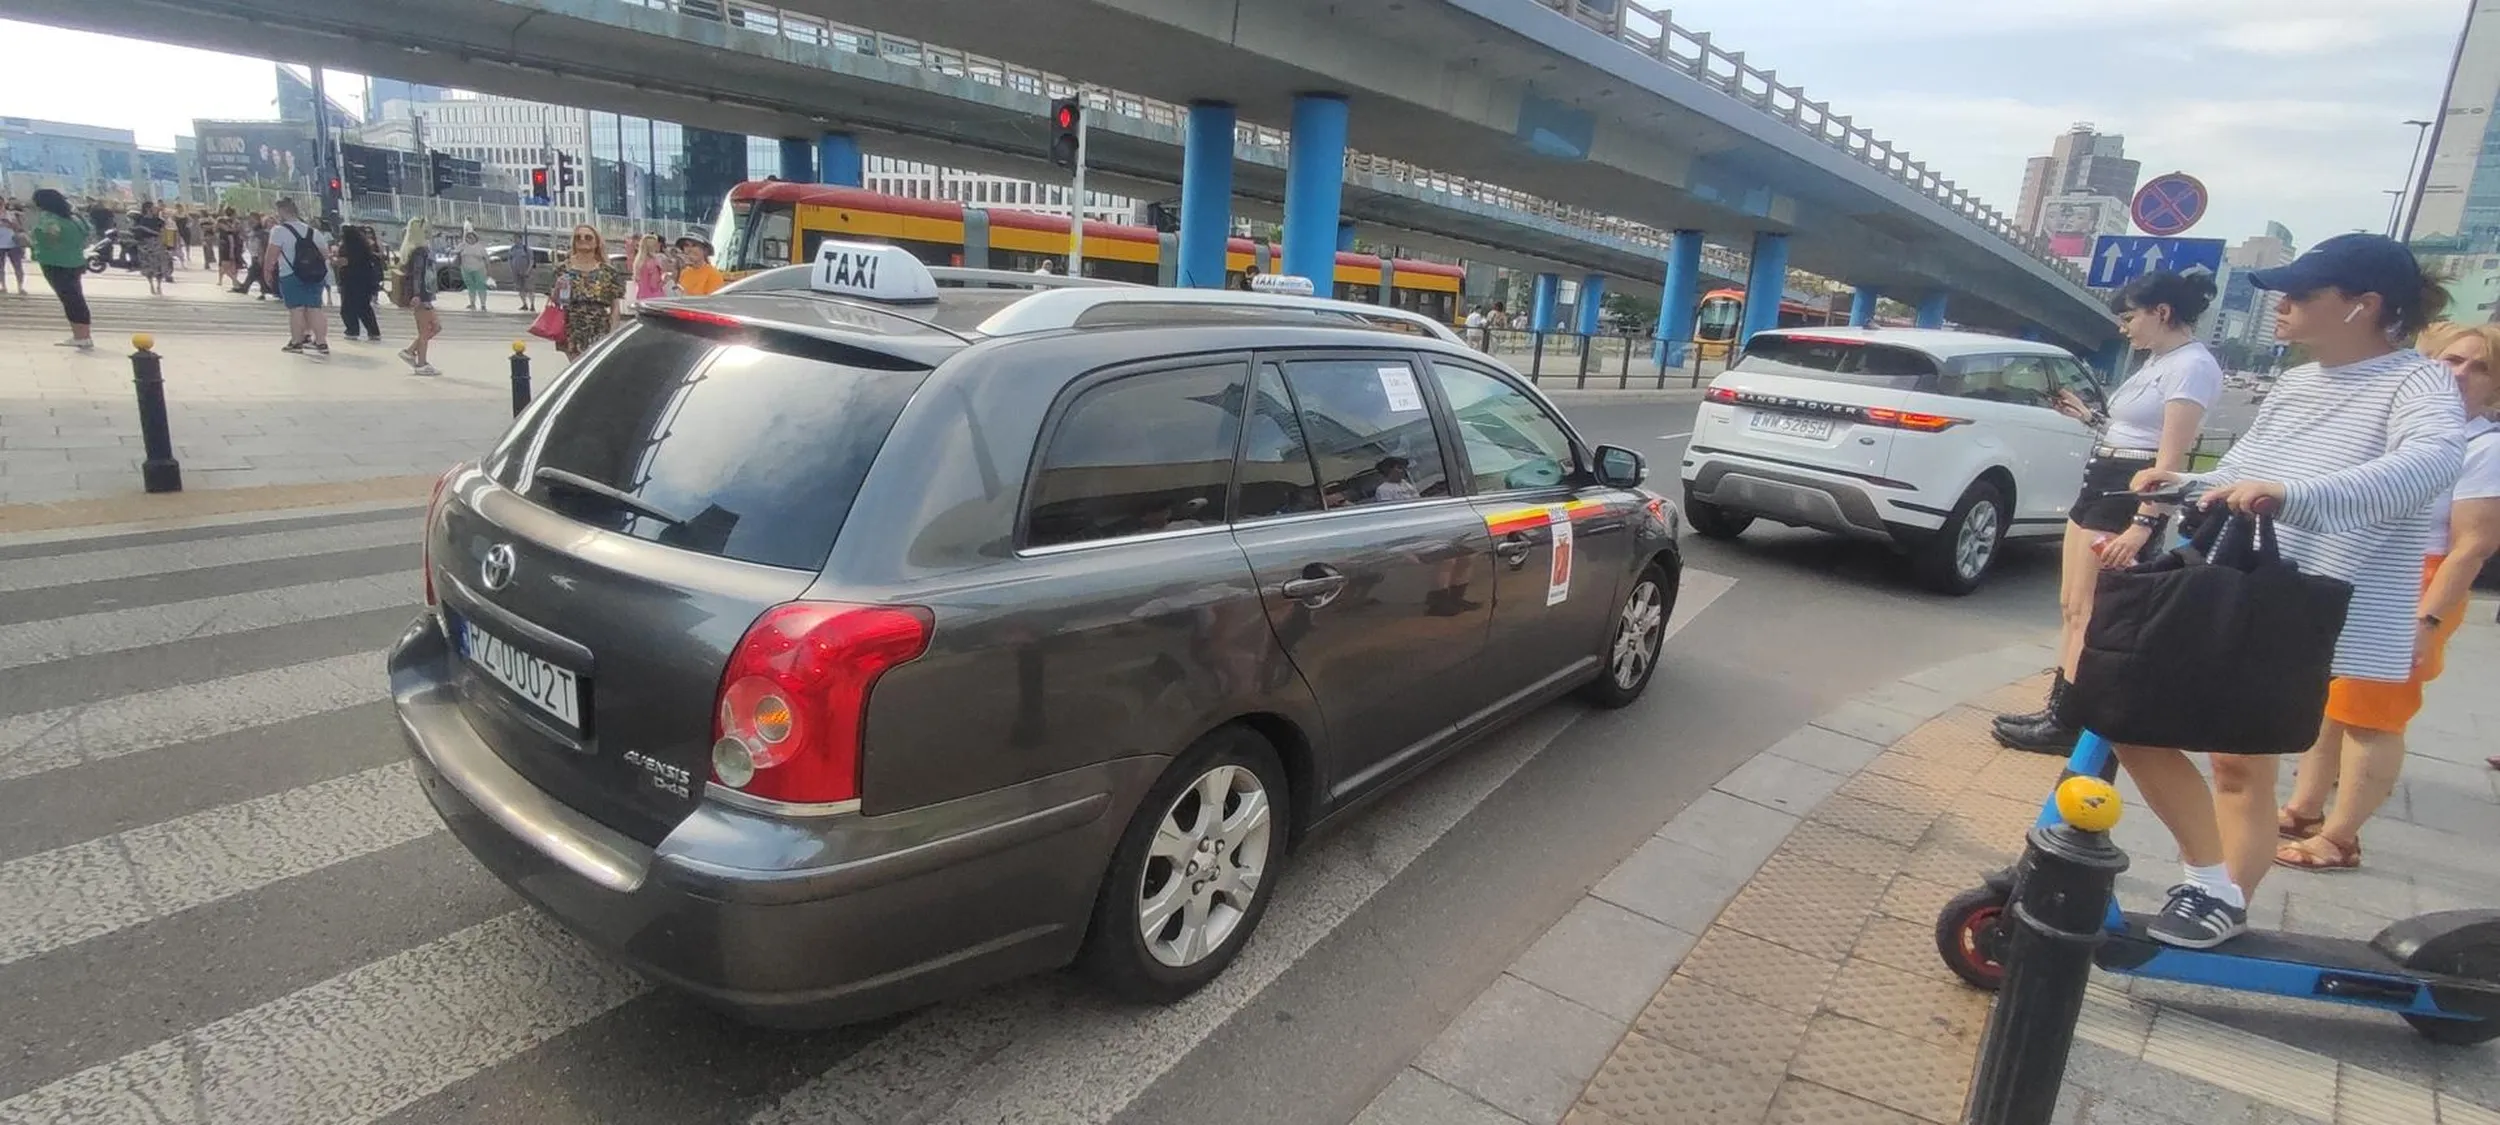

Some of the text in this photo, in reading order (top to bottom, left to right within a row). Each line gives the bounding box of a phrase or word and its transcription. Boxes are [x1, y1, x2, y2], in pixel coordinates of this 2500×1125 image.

[824, 251, 878, 289] TAXI
[1737, 393, 1857, 414] RANGE ROVER
[501, 640, 571, 719] 0002T
[623, 750, 690, 784] AVENSIS
